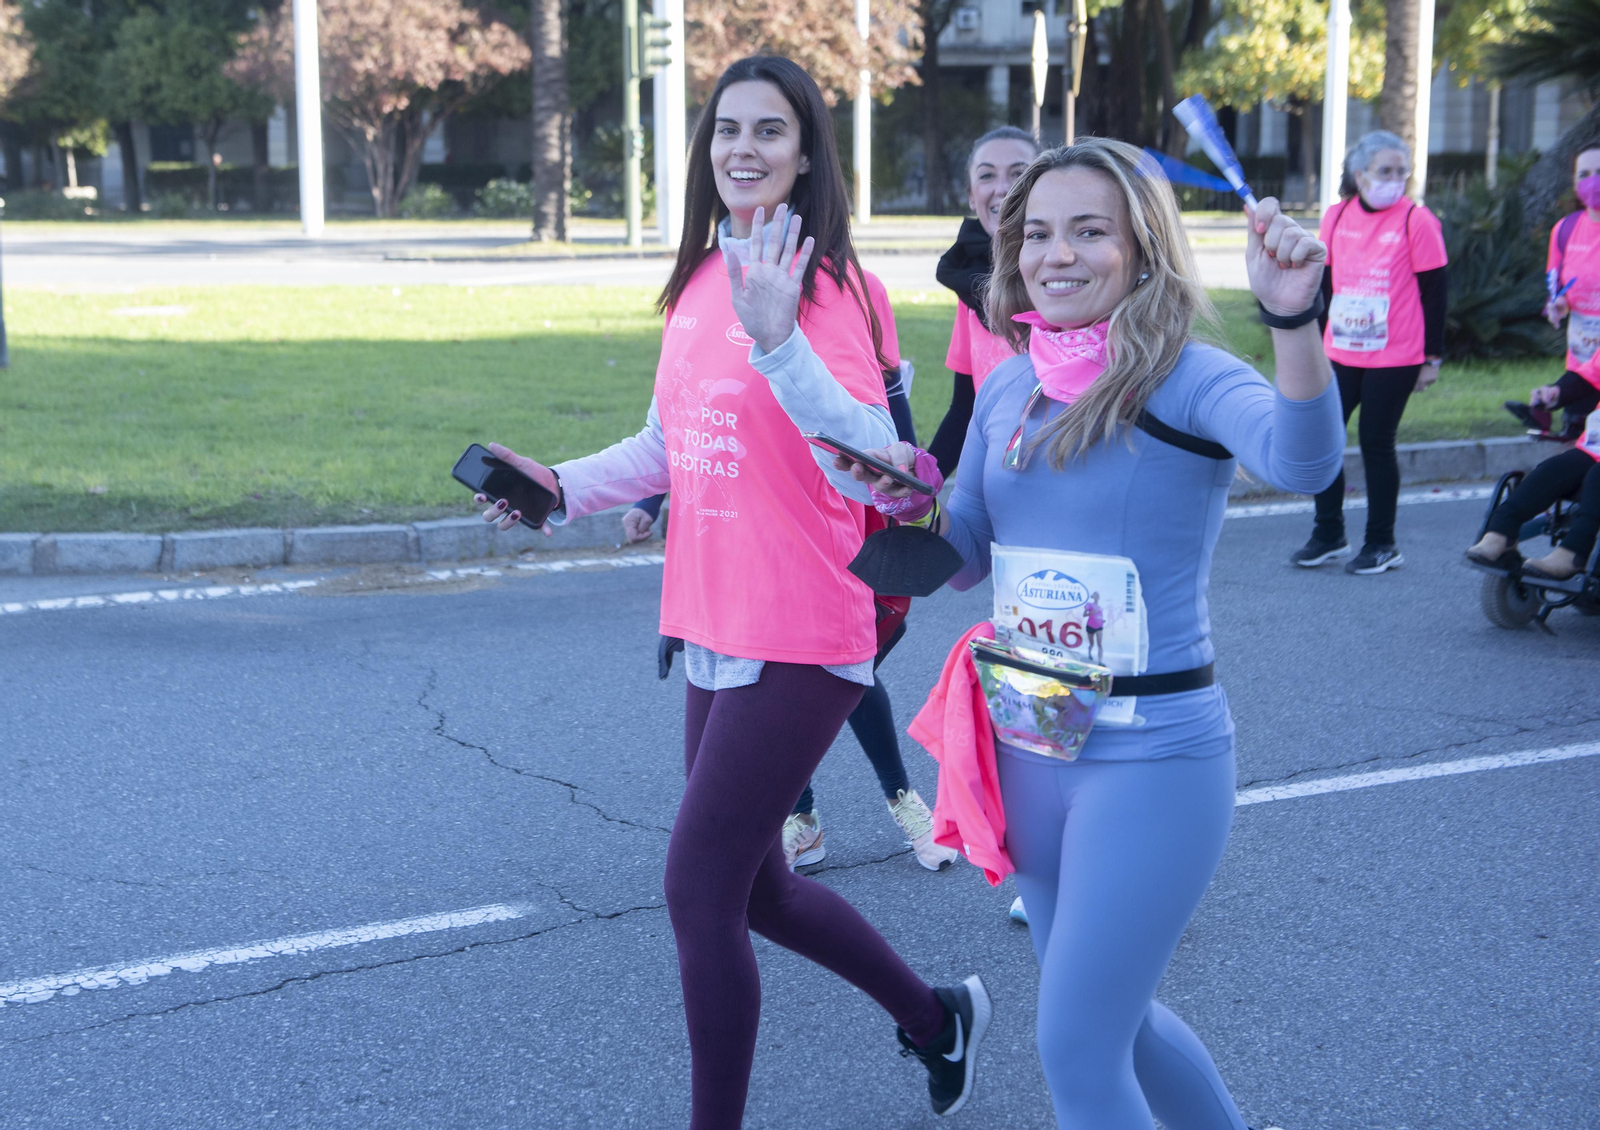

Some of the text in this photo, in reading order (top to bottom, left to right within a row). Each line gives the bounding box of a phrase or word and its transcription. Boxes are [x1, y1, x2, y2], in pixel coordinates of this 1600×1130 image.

[701, 407, 738, 430] POR
[684, 428, 738, 453] TODAS
[719, 509, 738, 518] 2021
[1020, 582, 1083, 602] ASTURIANA
[1017, 617, 1083, 648] 016
